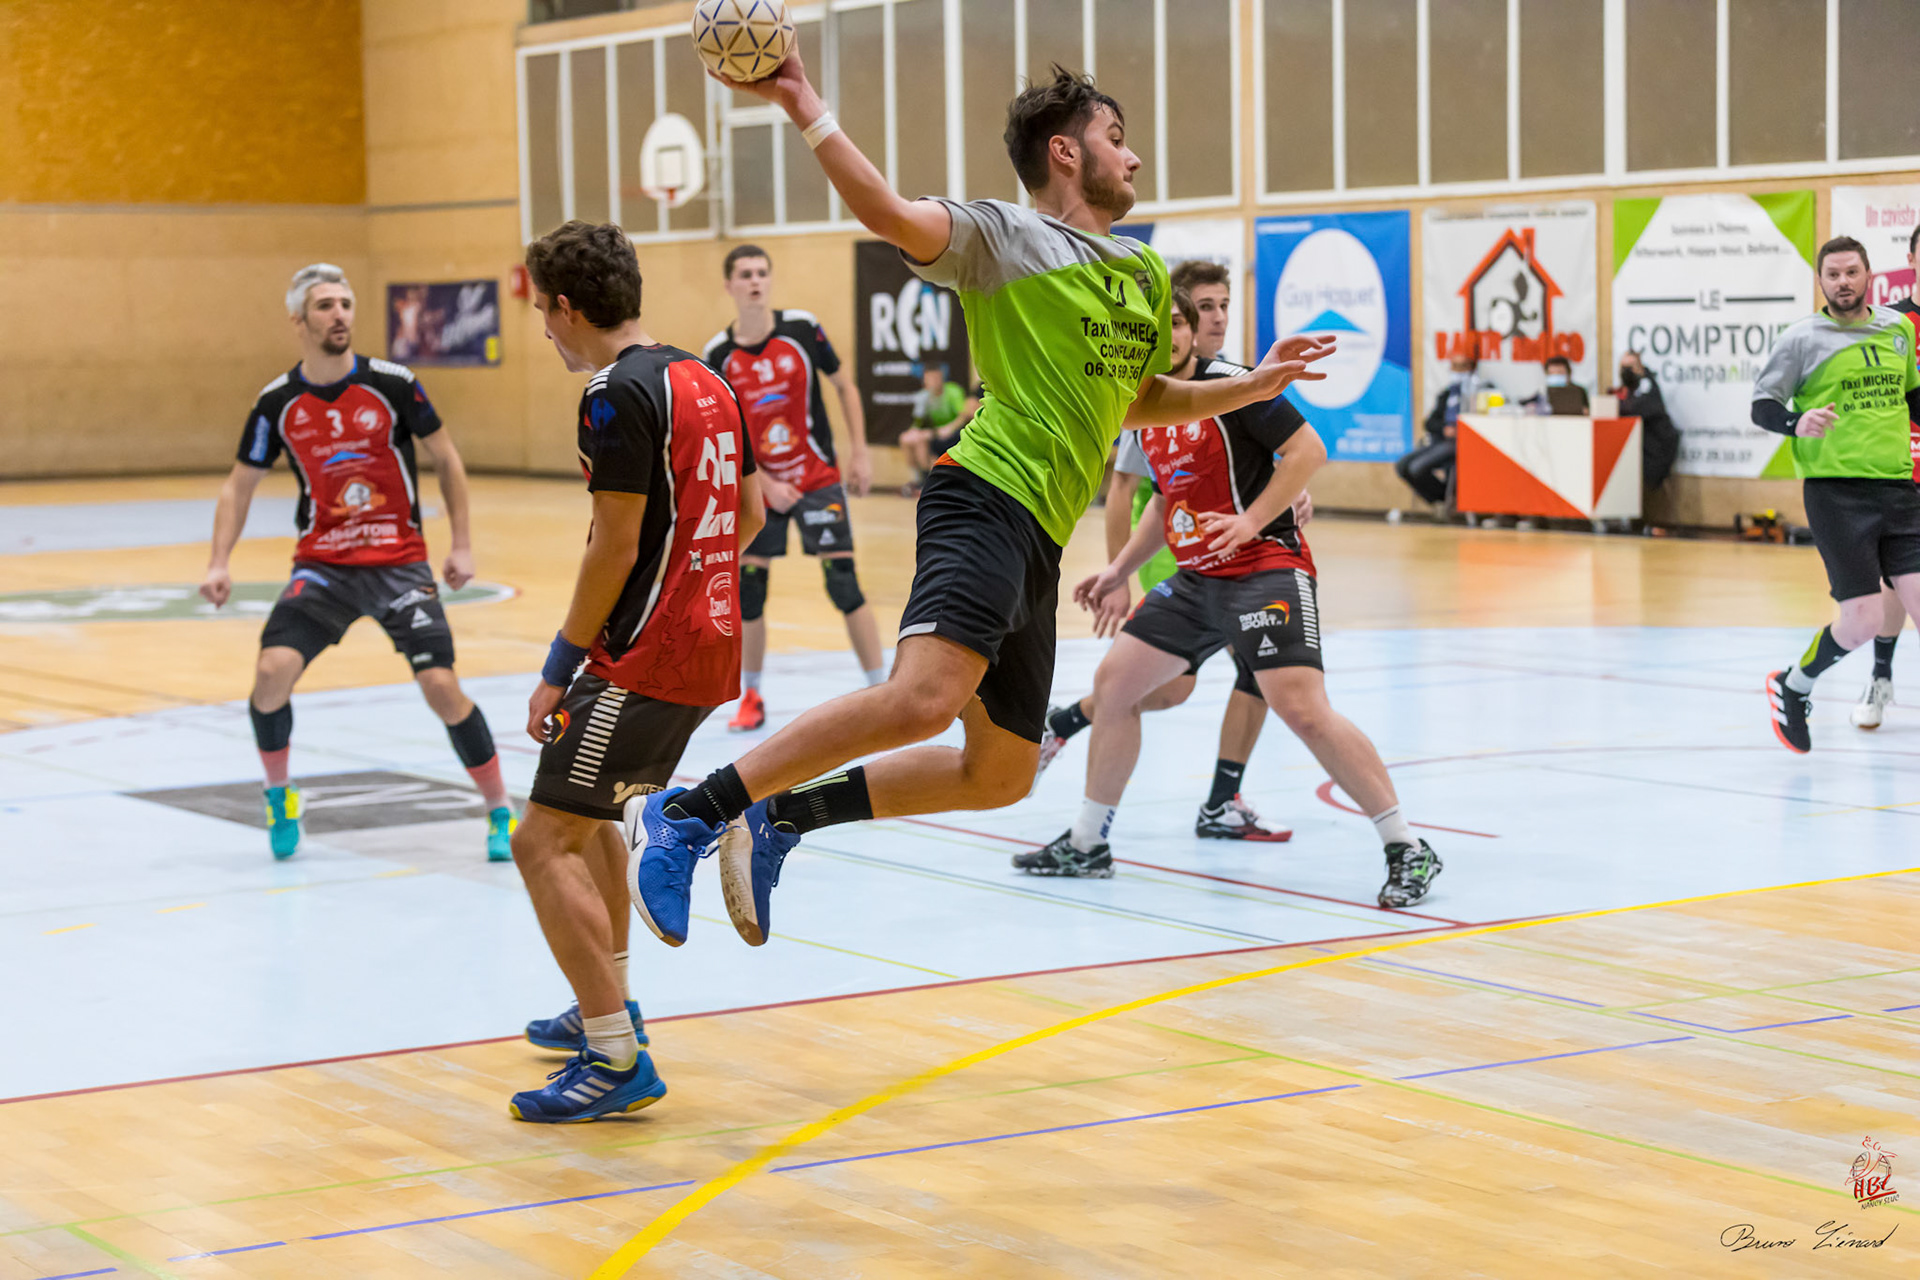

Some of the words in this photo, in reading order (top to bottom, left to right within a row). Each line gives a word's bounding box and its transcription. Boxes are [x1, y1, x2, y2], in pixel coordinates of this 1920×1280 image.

[1698, 288, 1720, 310] LE
[1080, 316, 1110, 339] Taxi
[1085, 361, 1104, 377] 06
[325, 408, 345, 439] 3
